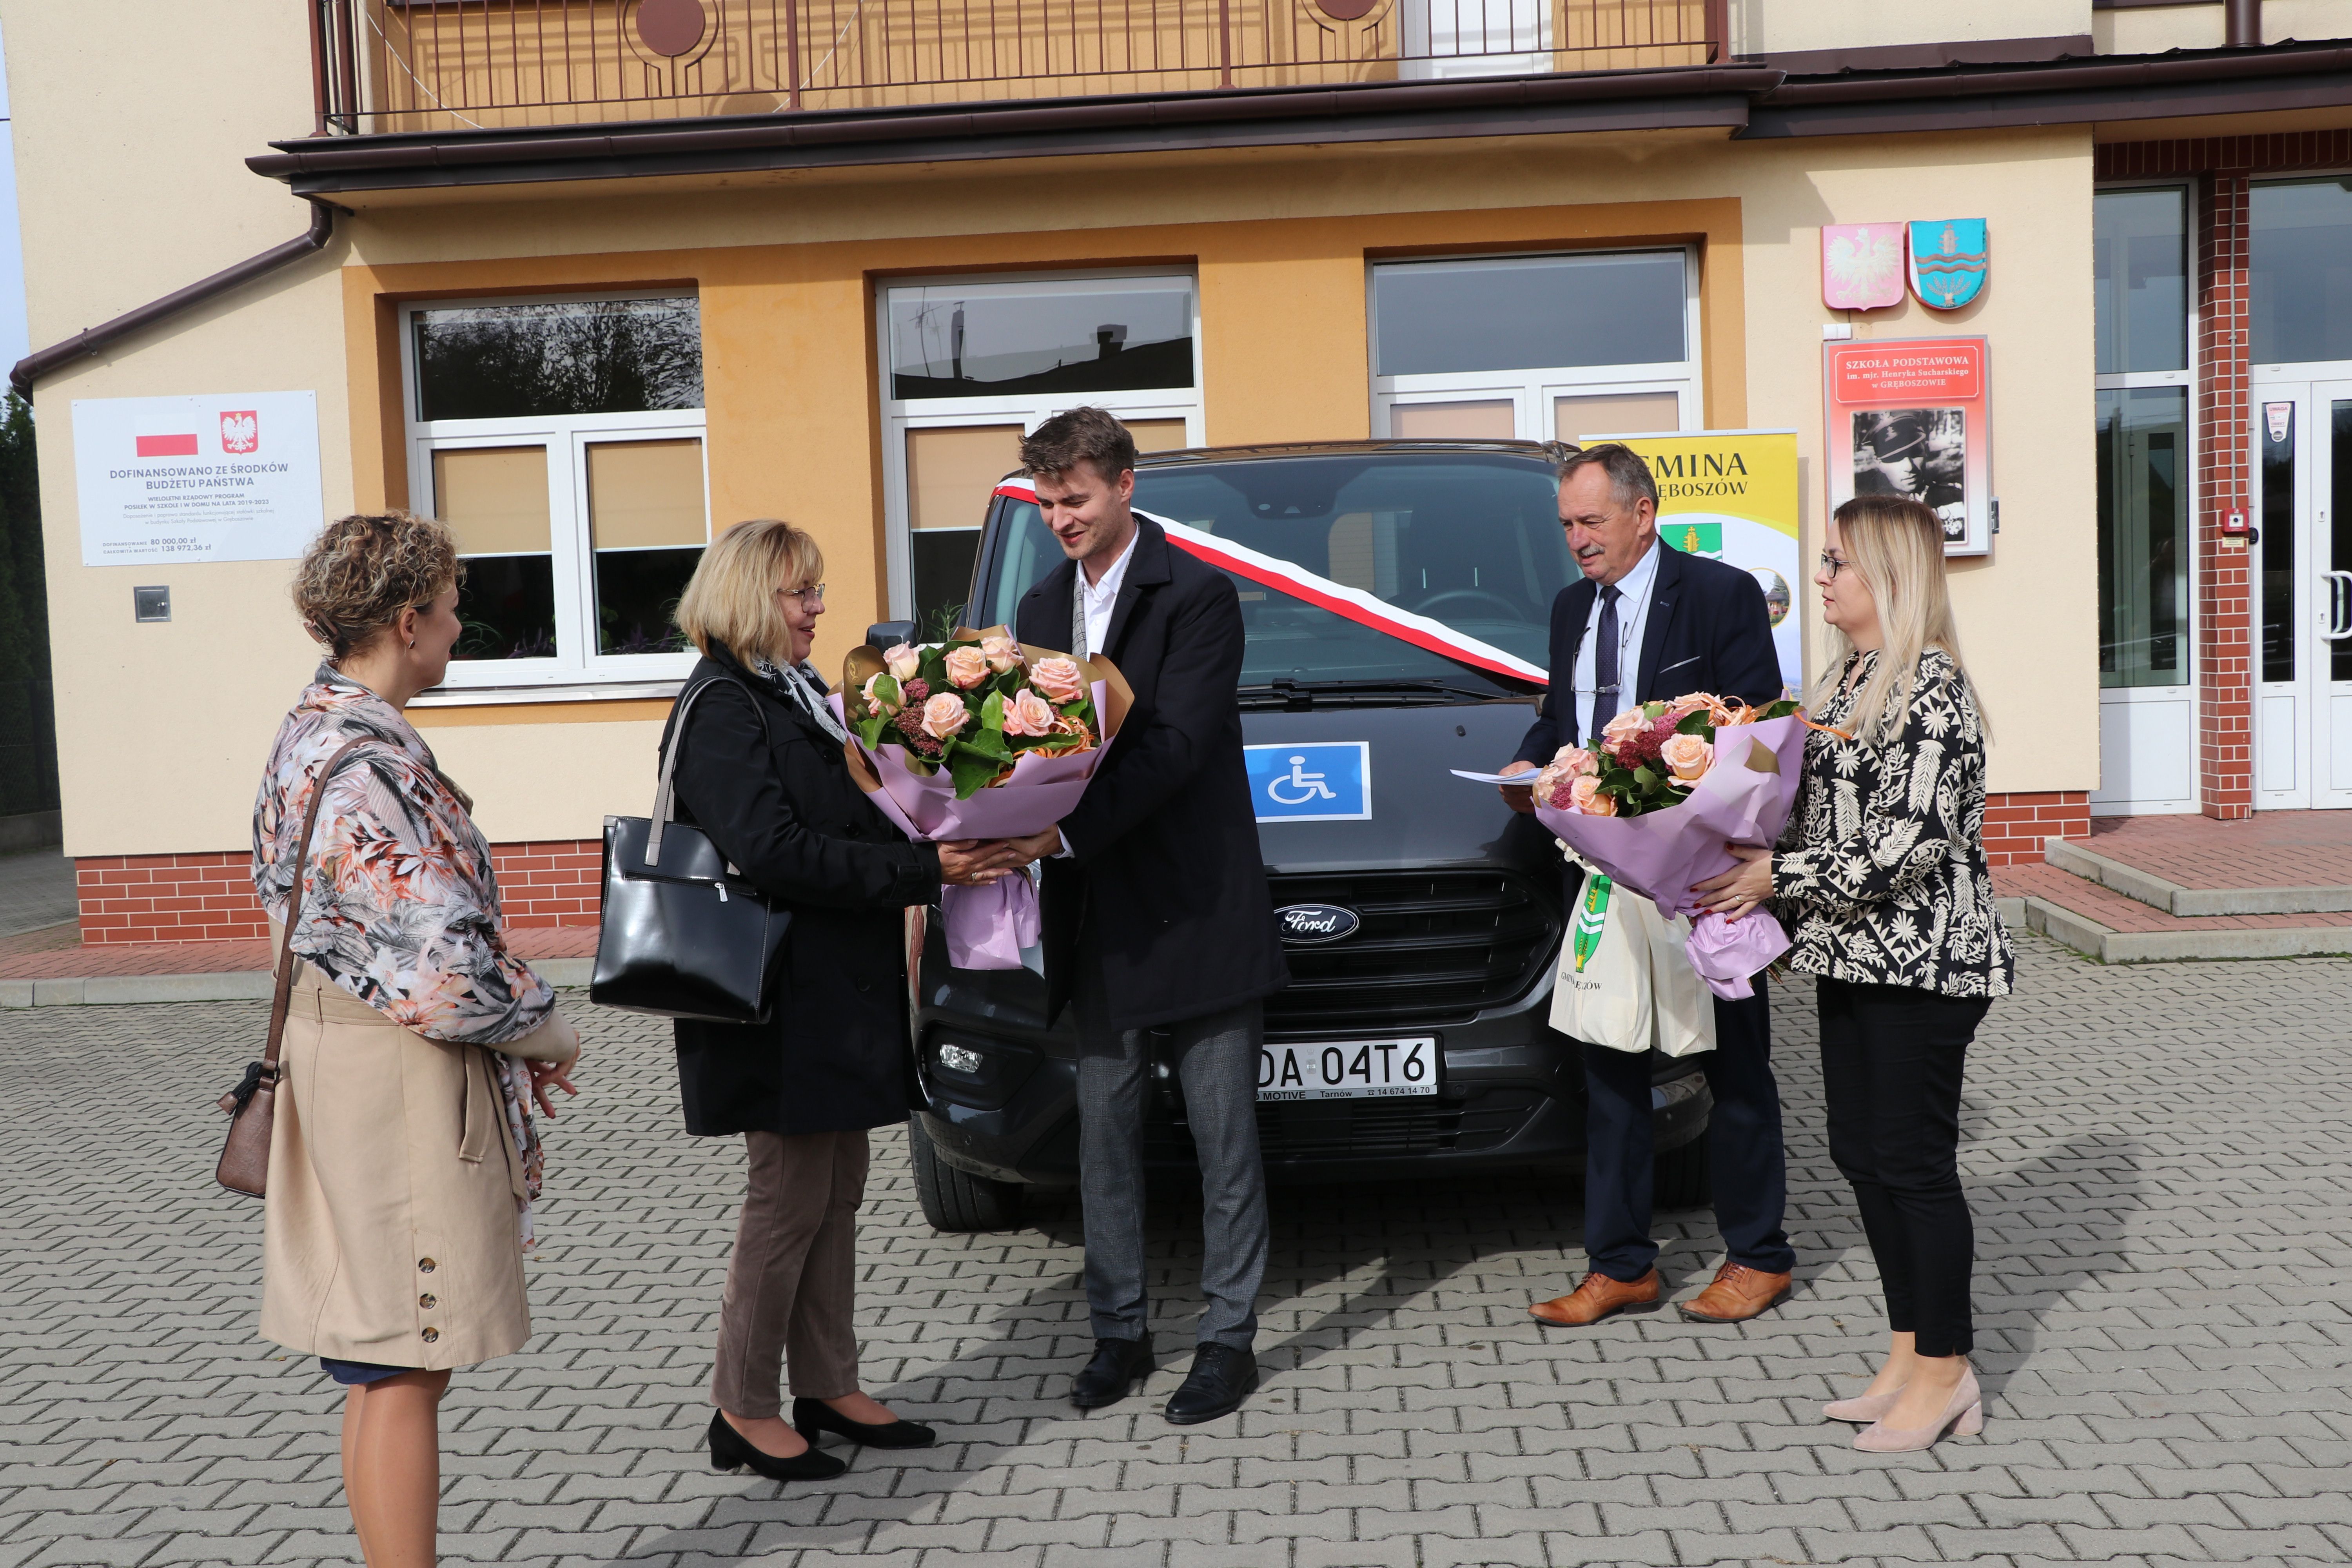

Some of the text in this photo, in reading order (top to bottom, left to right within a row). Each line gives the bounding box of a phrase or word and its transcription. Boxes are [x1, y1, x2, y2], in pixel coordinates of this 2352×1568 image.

[1846, 356, 1969, 369] SZKOŁA PODSTAWOWA
[1862, 372, 1879, 381] mjr.
[1882, 370, 1916, 379] Henryka
[1918, 368, 1969, 377] Sucharskiego
[1880, 379, 1946, 389] GRĘBOSZOWIE
[110, 461, 288, 479] DOFINANSOWANO ZE ŚRODKÓW
[146, 476, 254, 489] BUDŻETU PAŃSTWA
[1657, 478, 1748, 501] ĘBOSZÓW
[1280, 910, 1336, 934] Ford
[1258, 1043, 1425, 1088] DA 04T6
[1263, 1091, 1306, 1100] MOTIVE
